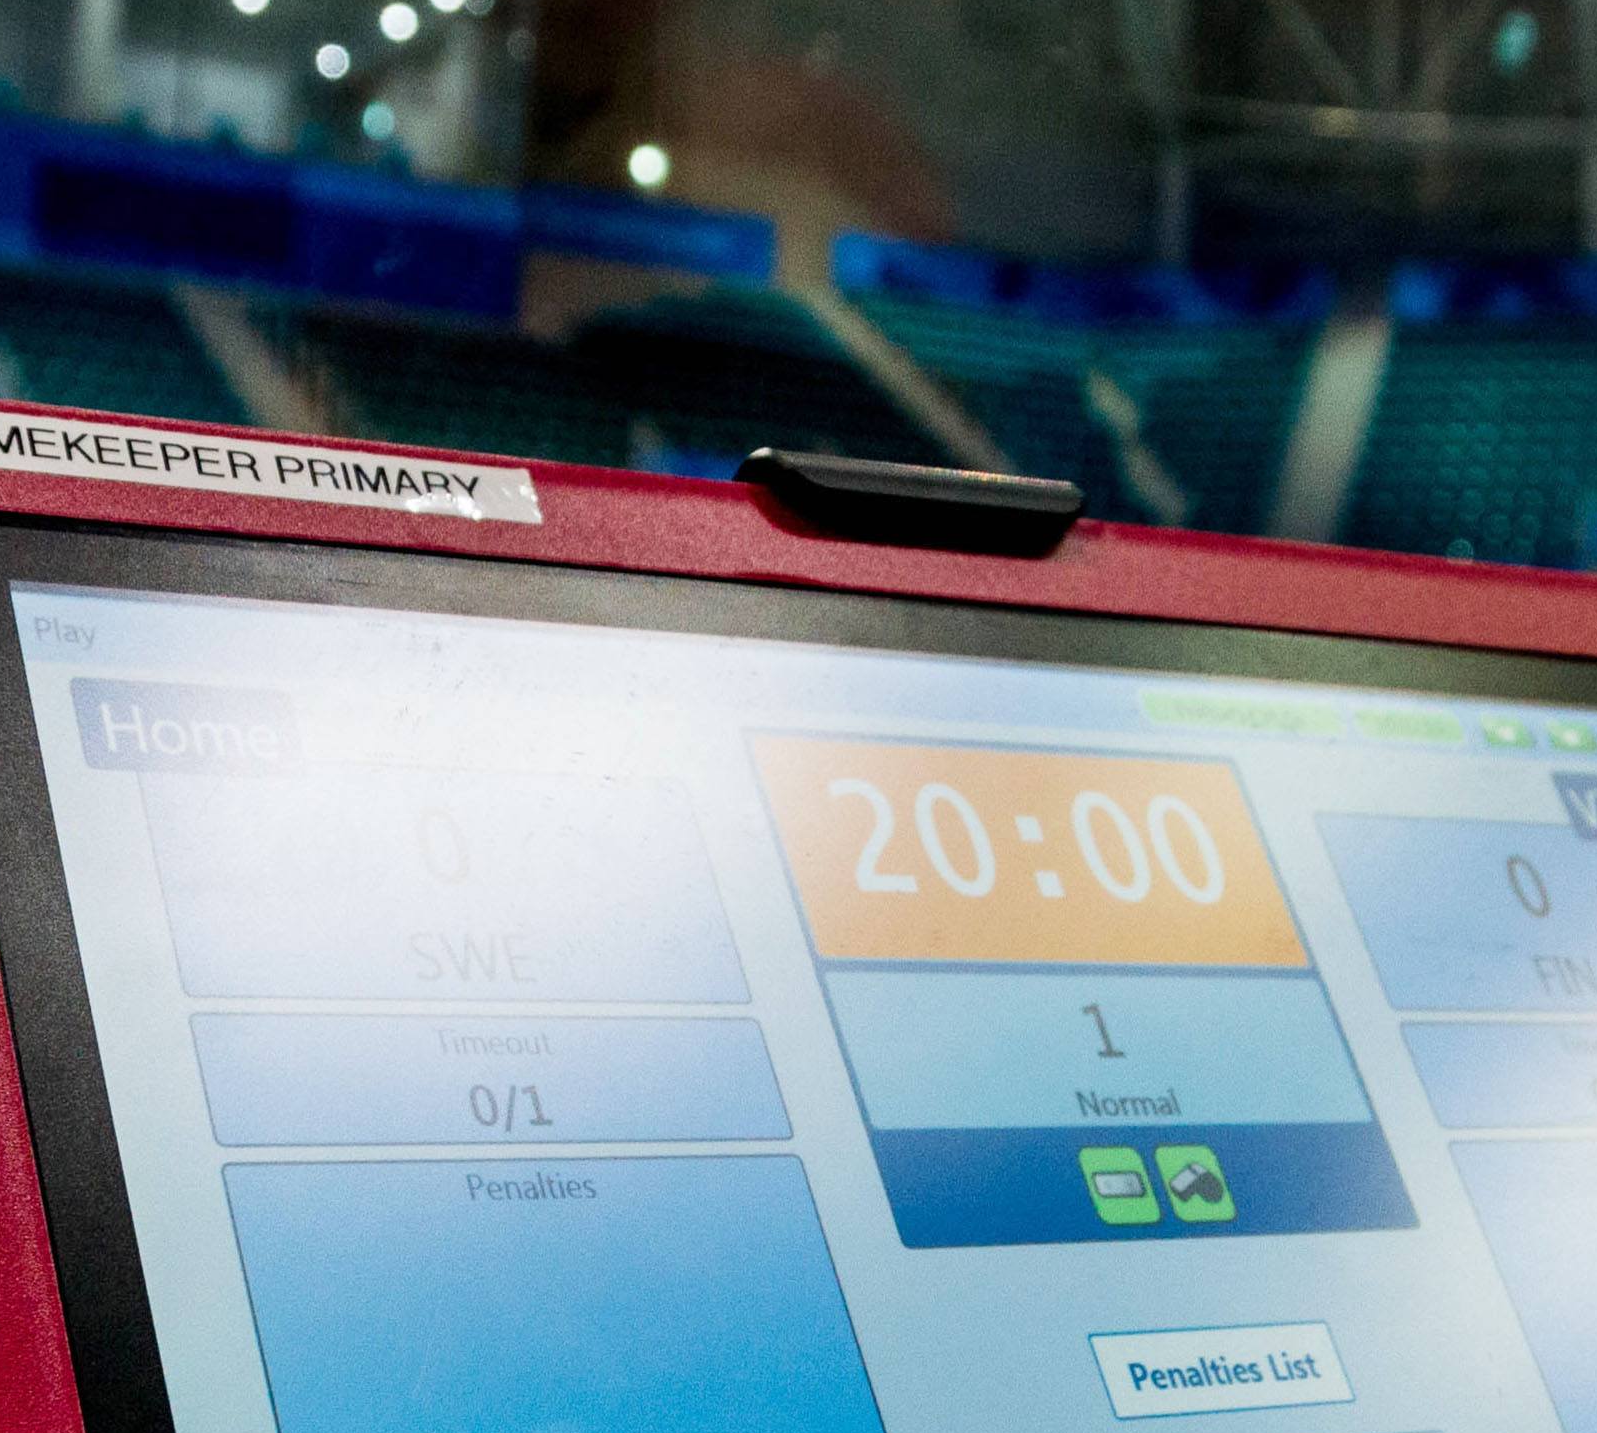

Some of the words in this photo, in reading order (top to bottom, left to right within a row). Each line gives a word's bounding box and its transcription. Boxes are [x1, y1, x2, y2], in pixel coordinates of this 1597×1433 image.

[278, 455, 482, 502] PRIMARY
[33, 615, 97, 649] Play
[102, 703, 283, 760] Home
[827, 777, 1226, 906] 20:00
[1506, 853, 1552, 919] 0
[406, 930, 539, 984] SWE
[436, 1027, 555, 1057] Timeout
[1082, 1002, 1128, 1060] 1
[467, 1082, 554, 1133] 0/1
[1075, 1087, 1182, 1119] Normal
[464, 1171, 598, 1203] Penalties
[1127, 1356, 1264, 1393] Penalties
[1267, 1352, 1322, 1383] List
